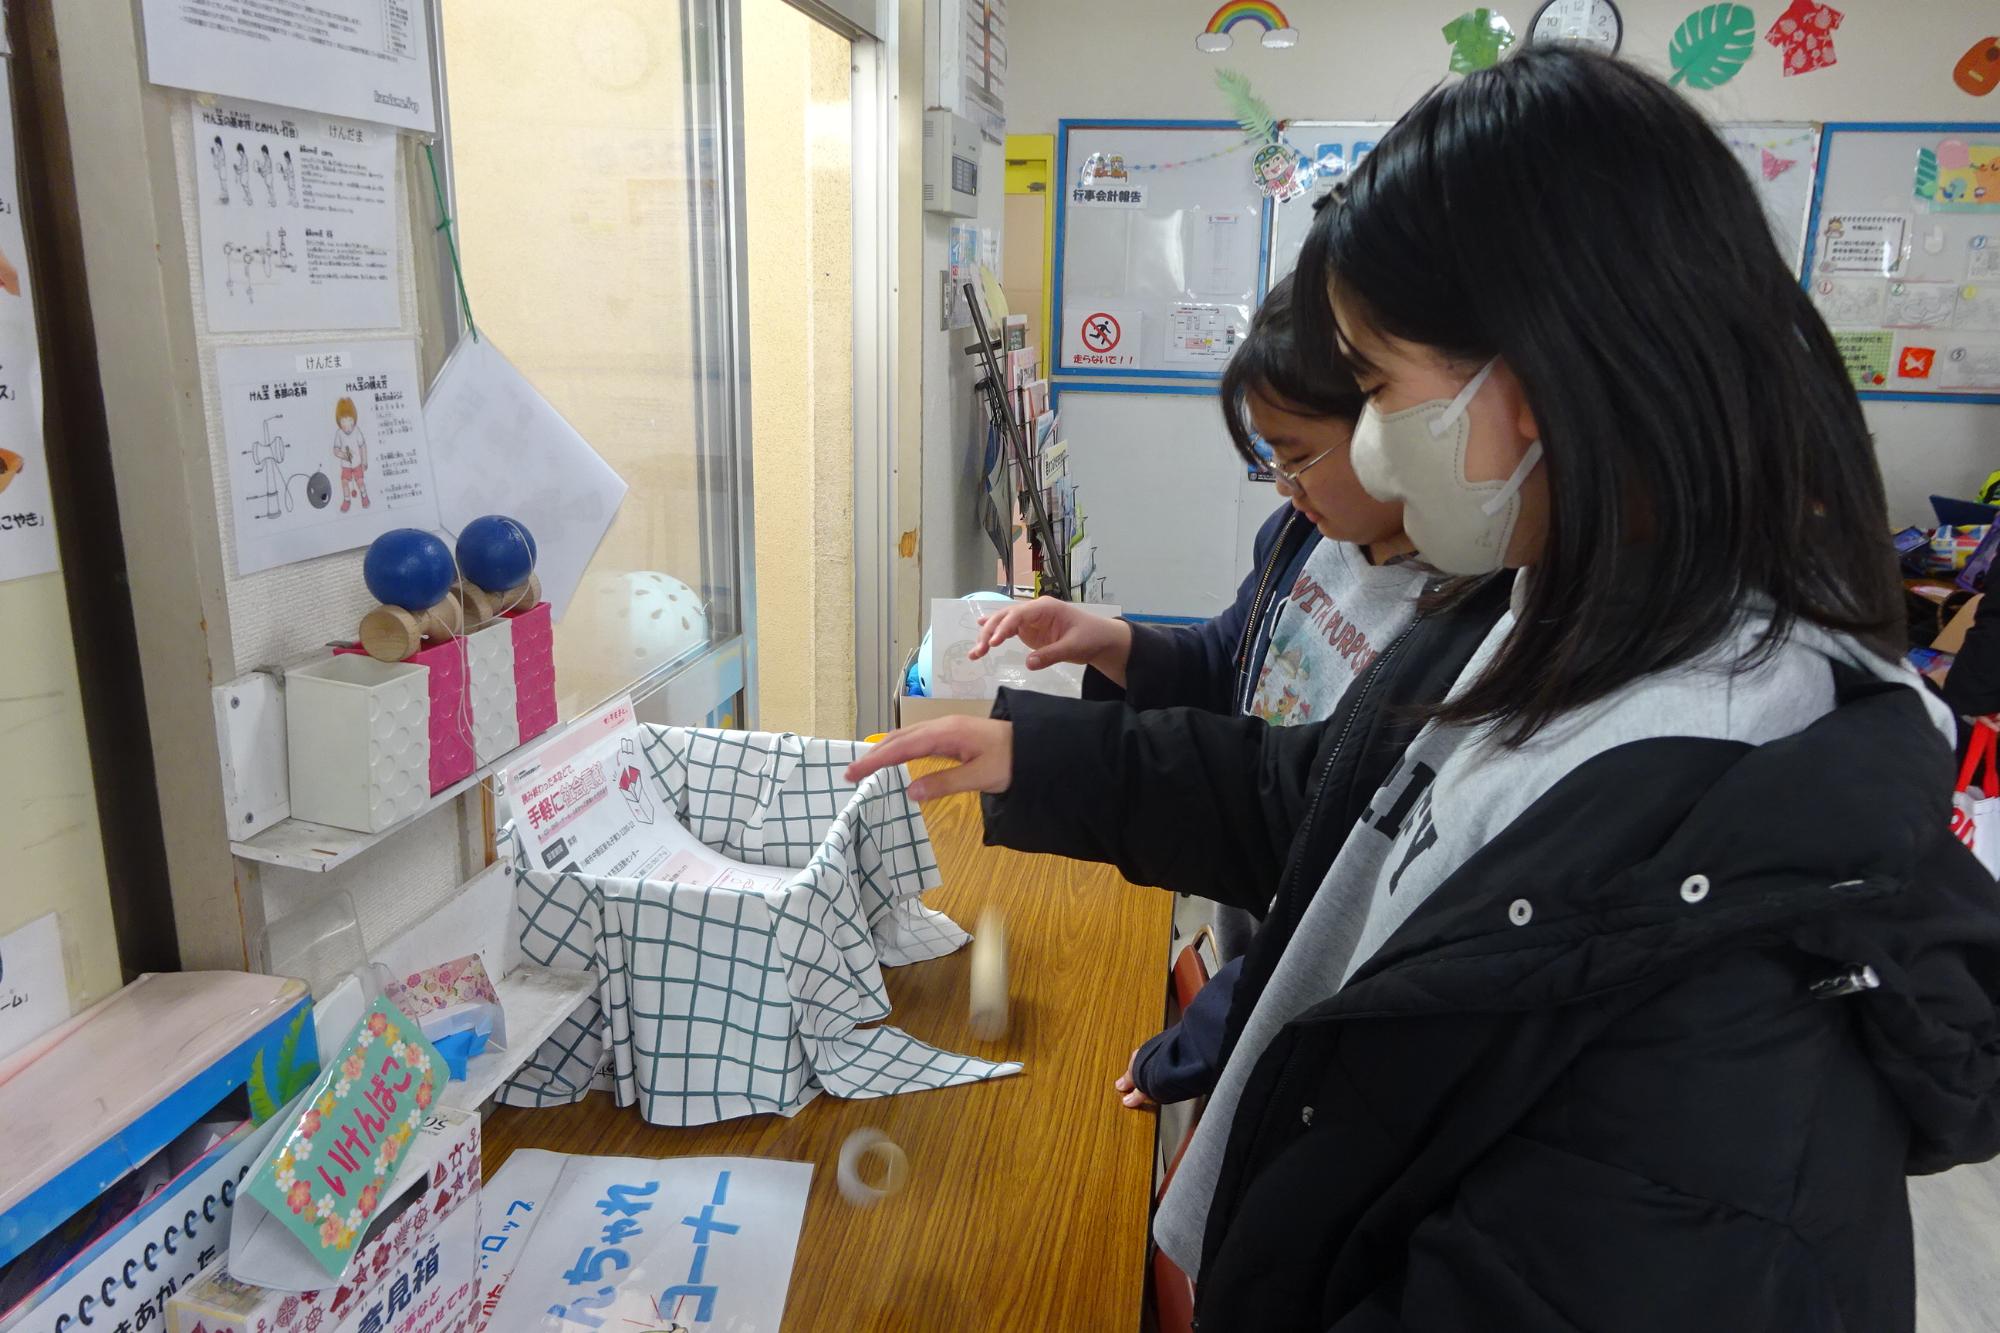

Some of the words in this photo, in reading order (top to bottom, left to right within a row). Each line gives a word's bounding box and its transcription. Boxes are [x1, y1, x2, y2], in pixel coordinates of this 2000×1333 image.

[328, 125, 364, 143] けんだま
[1073, 189, 1142, 203] 行事会計報告
[305, 355, 342, 369] けんだま
[1291, 575, 1331, 632] WITH
[316, 1055, 413, 1198] いけんばこ
[659, 1169, 741, 1323] コーナー
